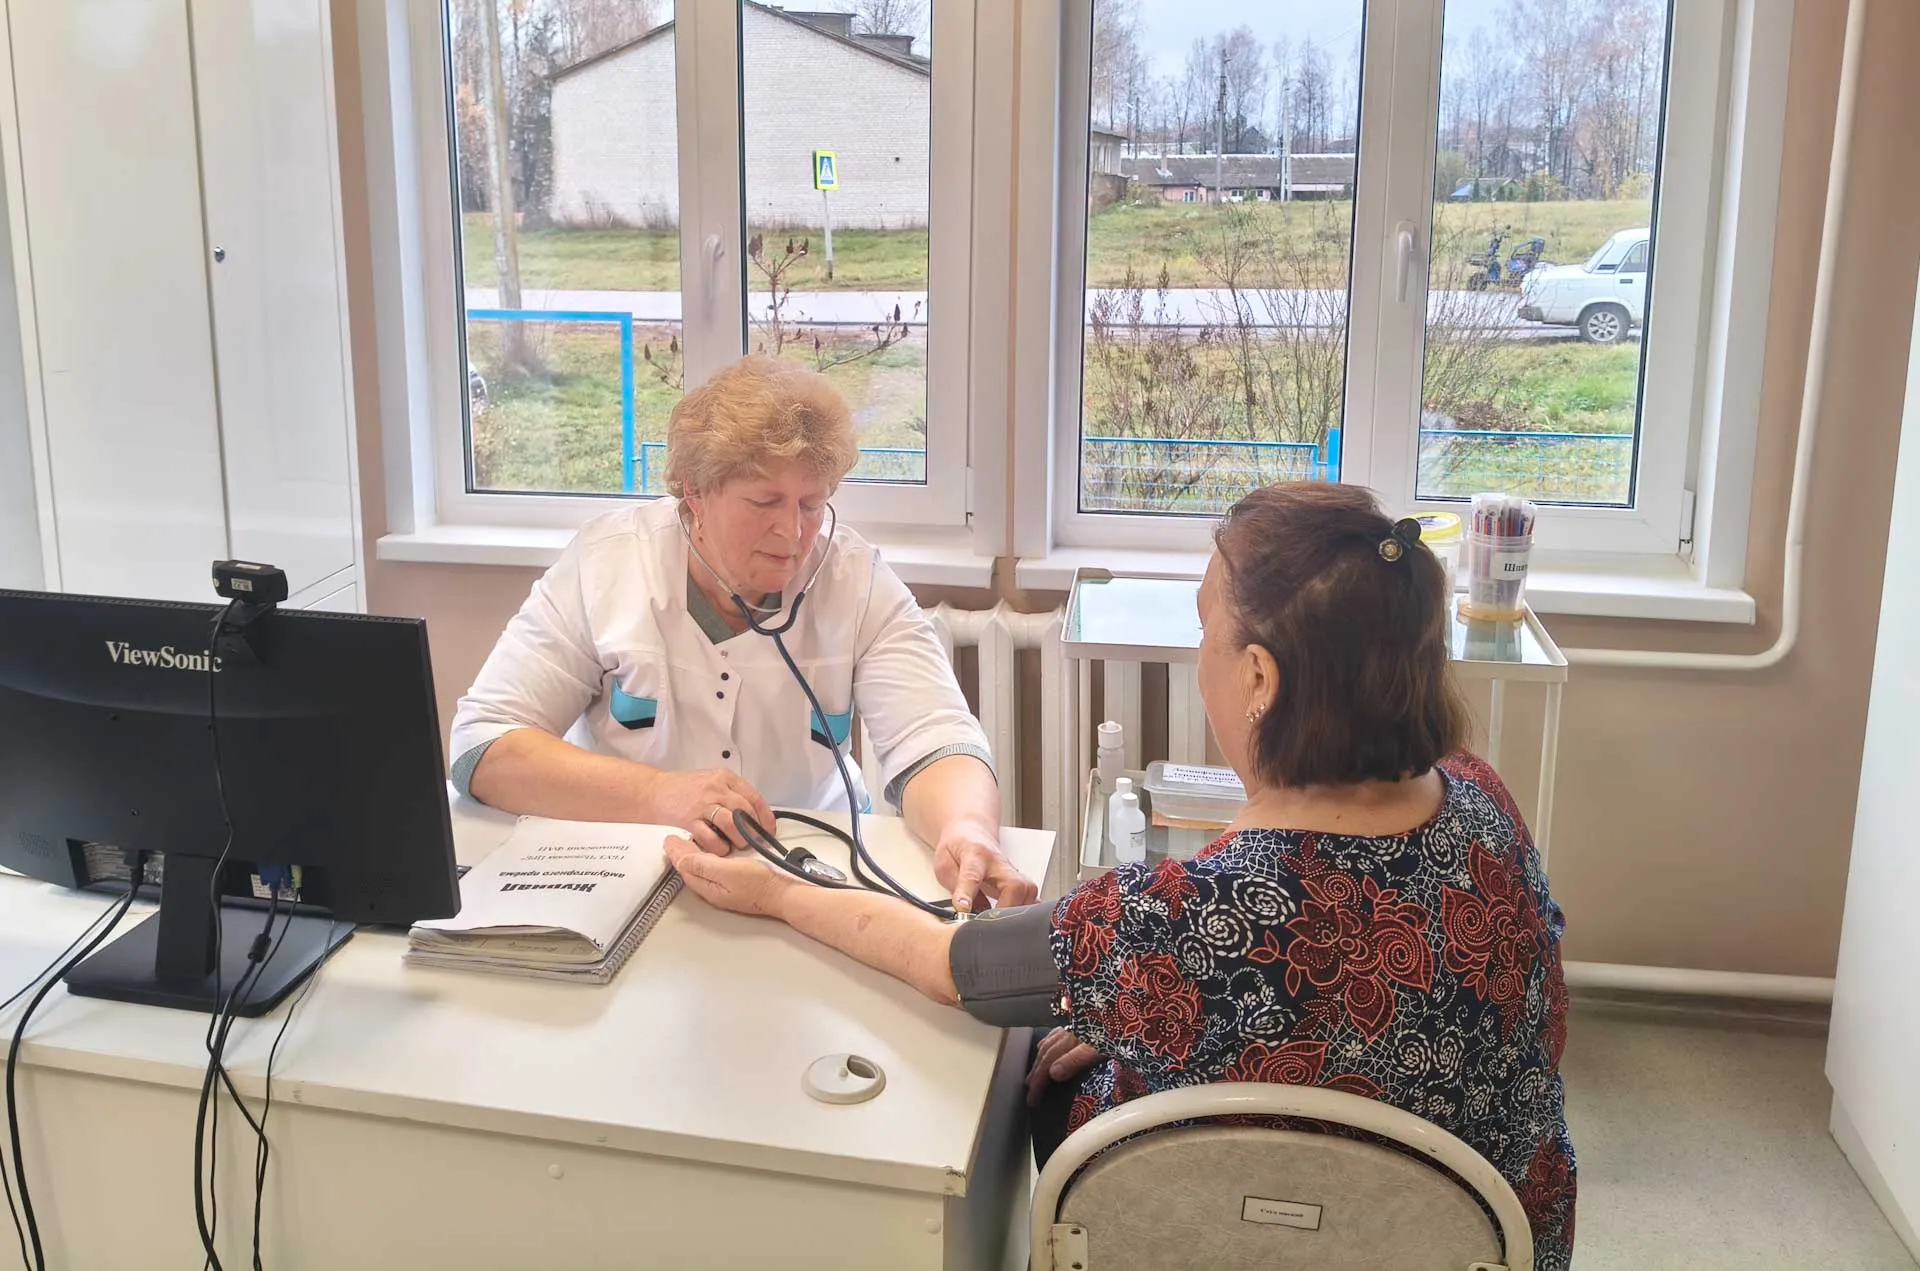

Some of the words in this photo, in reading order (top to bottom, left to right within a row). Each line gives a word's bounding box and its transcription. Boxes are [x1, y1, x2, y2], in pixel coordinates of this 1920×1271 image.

[105, 640, 223, 673] ViewSonic
[542, 869, 625, 878] амбулаторного
[500, 883, 597, 893] Журнал
